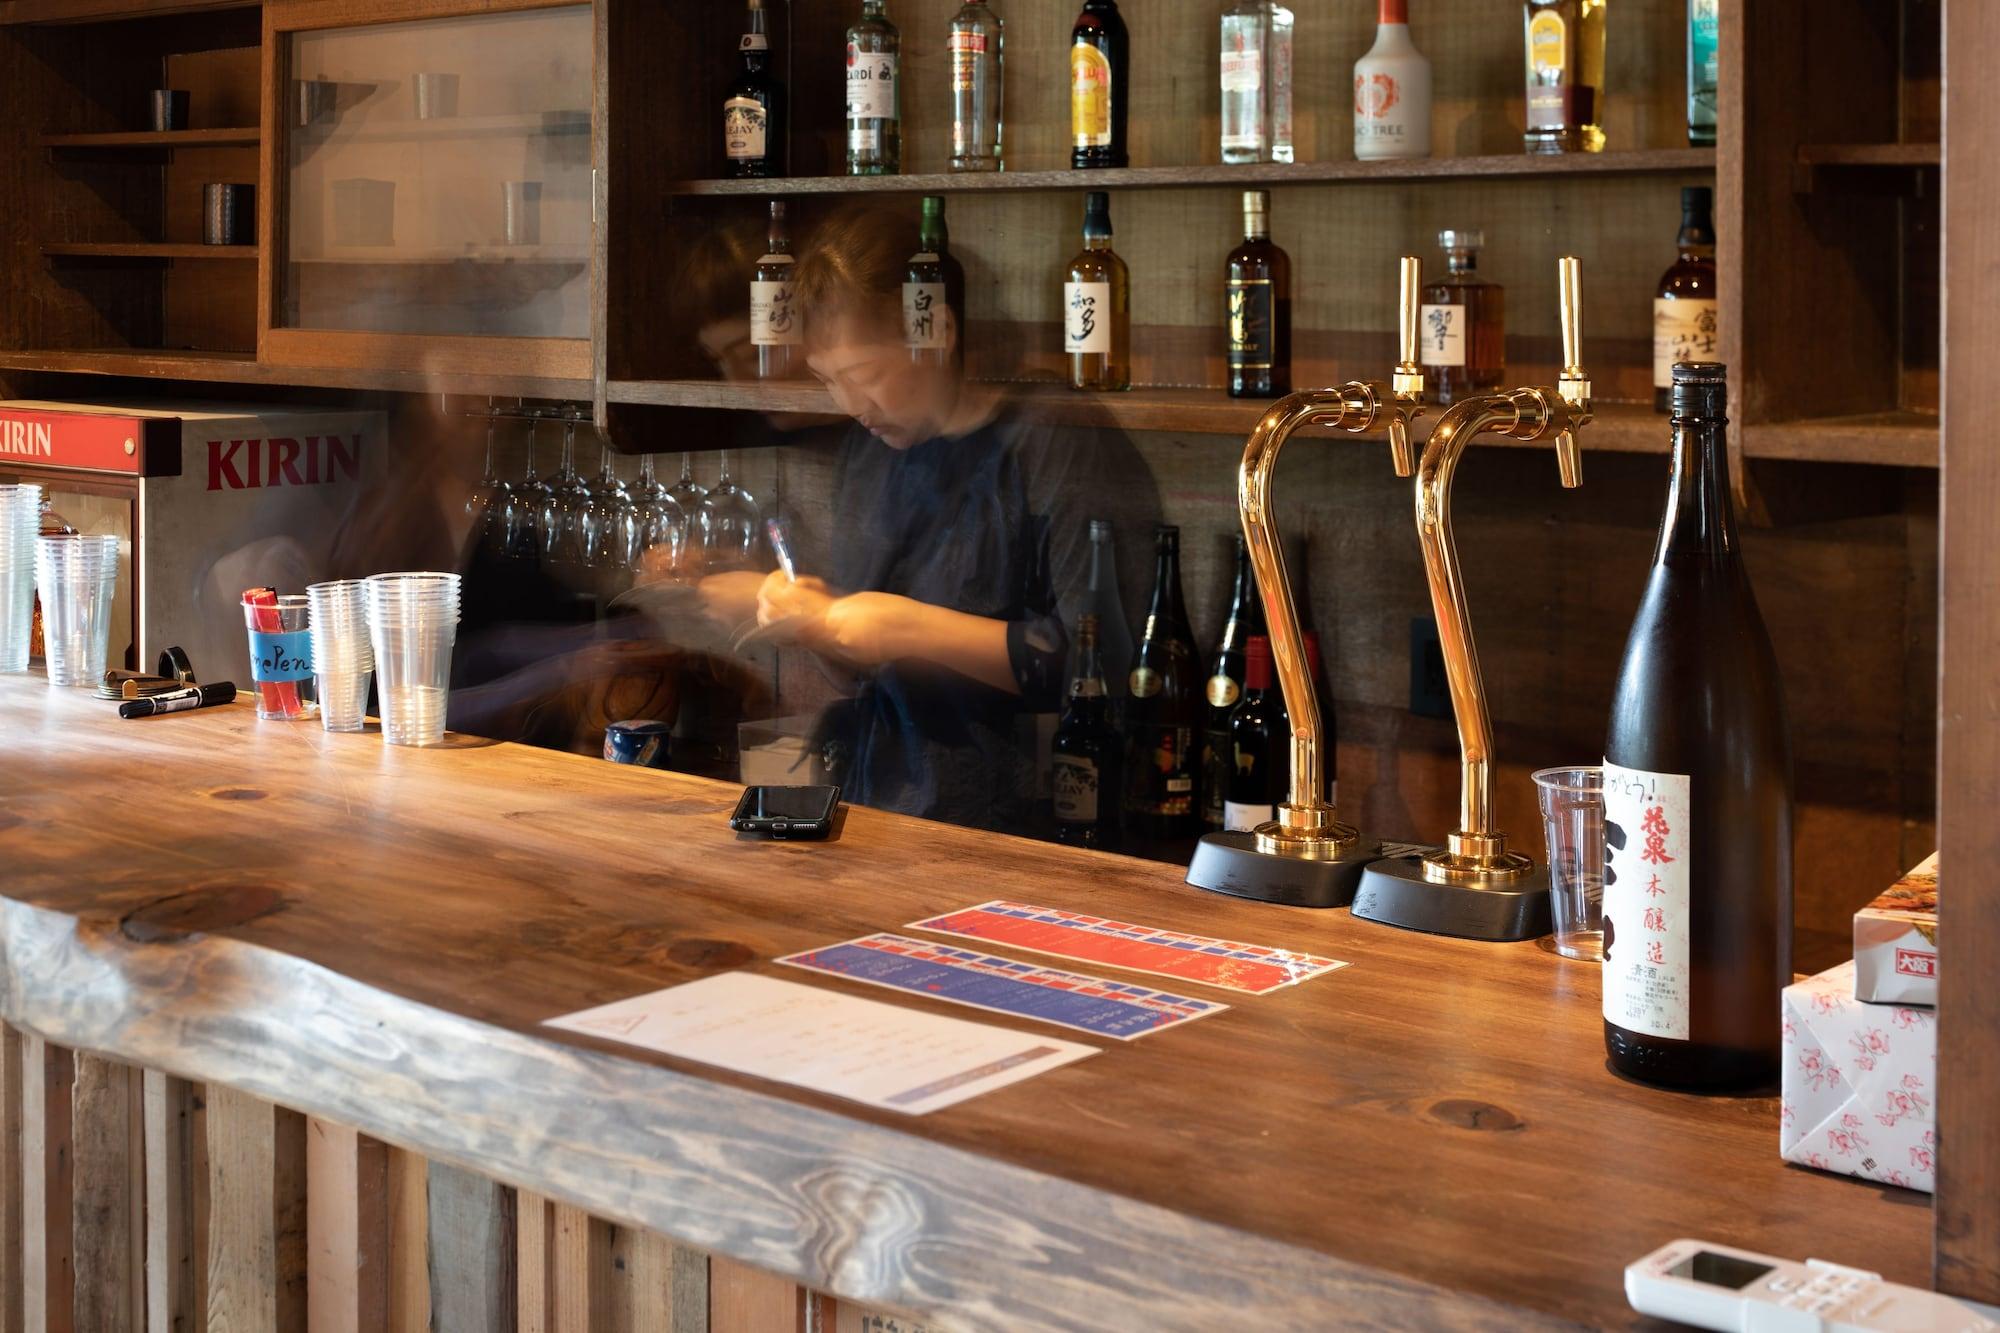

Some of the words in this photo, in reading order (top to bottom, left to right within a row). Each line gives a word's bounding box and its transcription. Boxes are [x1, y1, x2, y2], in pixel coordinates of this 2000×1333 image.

[913, 289, 934, 340] 白州
[1071, 288, 1096, 341] 知多
[1428, 309, 1458, 351] 響
[206, 434, 361, 491] KIRIN
[1603, 774, 1655, 803] がとう!
[1640, 805, 1677, 865] 花泉
[1643, 873, 1668, 965] 本醸造
